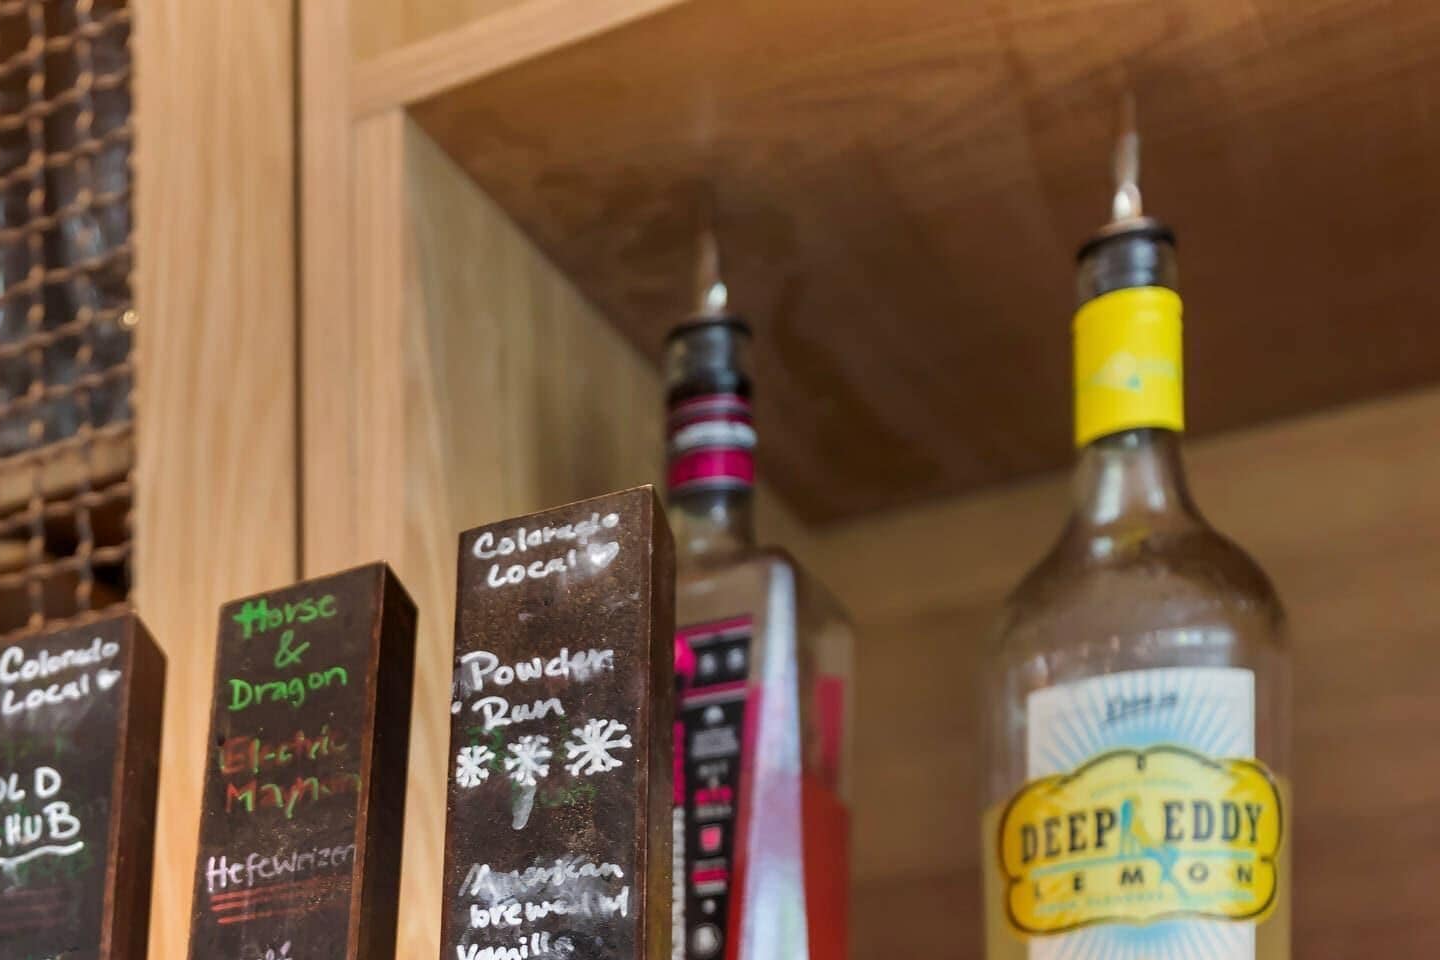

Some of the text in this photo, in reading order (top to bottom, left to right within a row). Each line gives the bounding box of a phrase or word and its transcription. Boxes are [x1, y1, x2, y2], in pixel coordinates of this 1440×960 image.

[472, 512, 620, 560] Colorado
[487, 548, 577, 589] Local
[233, 594, 337, 640] Horse
[273, 629, 310, 669] &
[0, 673, 90, 716] Local
[228, 666, 348, 711] Dragon
[471, 695, 565, 734] Run
[1020, 800, 1264, 865] DEEP EDDY
